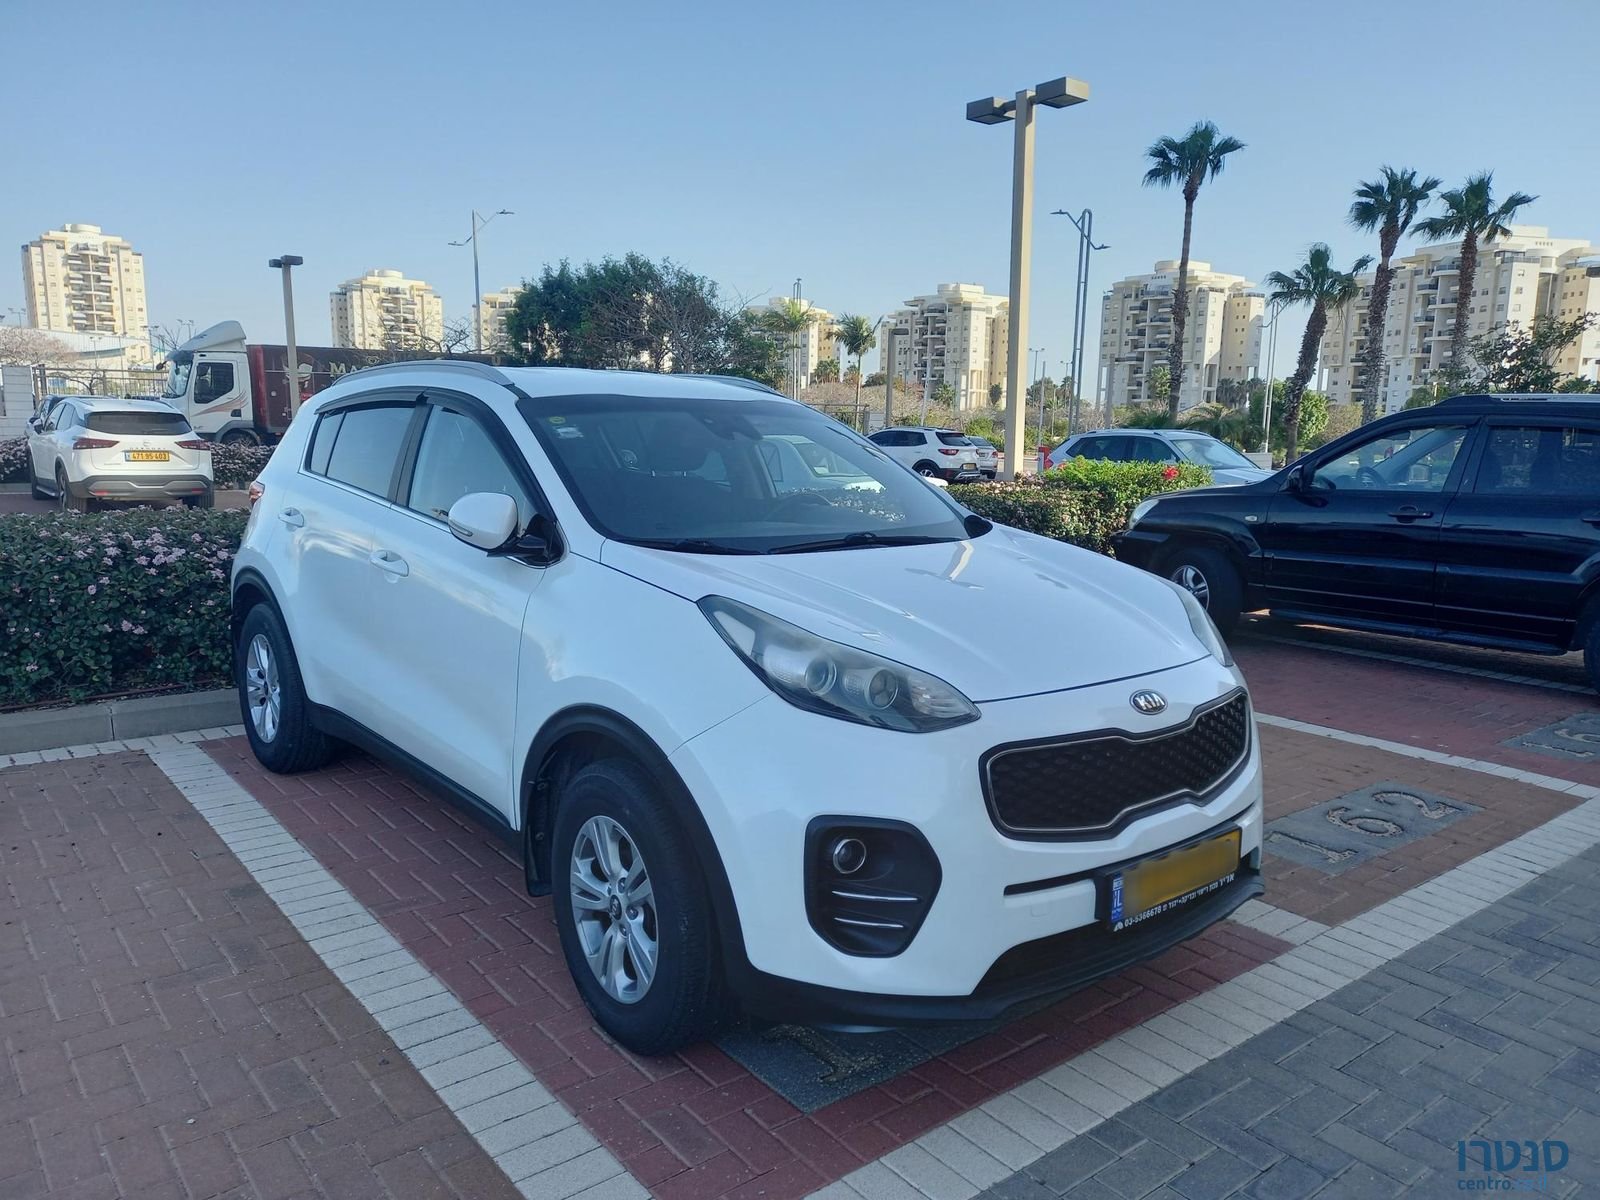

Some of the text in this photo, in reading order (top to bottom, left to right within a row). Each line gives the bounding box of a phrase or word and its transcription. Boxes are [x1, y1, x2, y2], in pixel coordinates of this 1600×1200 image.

[1134, 692, 1166, 711] KIA
[1522, 718, 1600, 757] 16
[1266, 790, 1463, 864] 162
